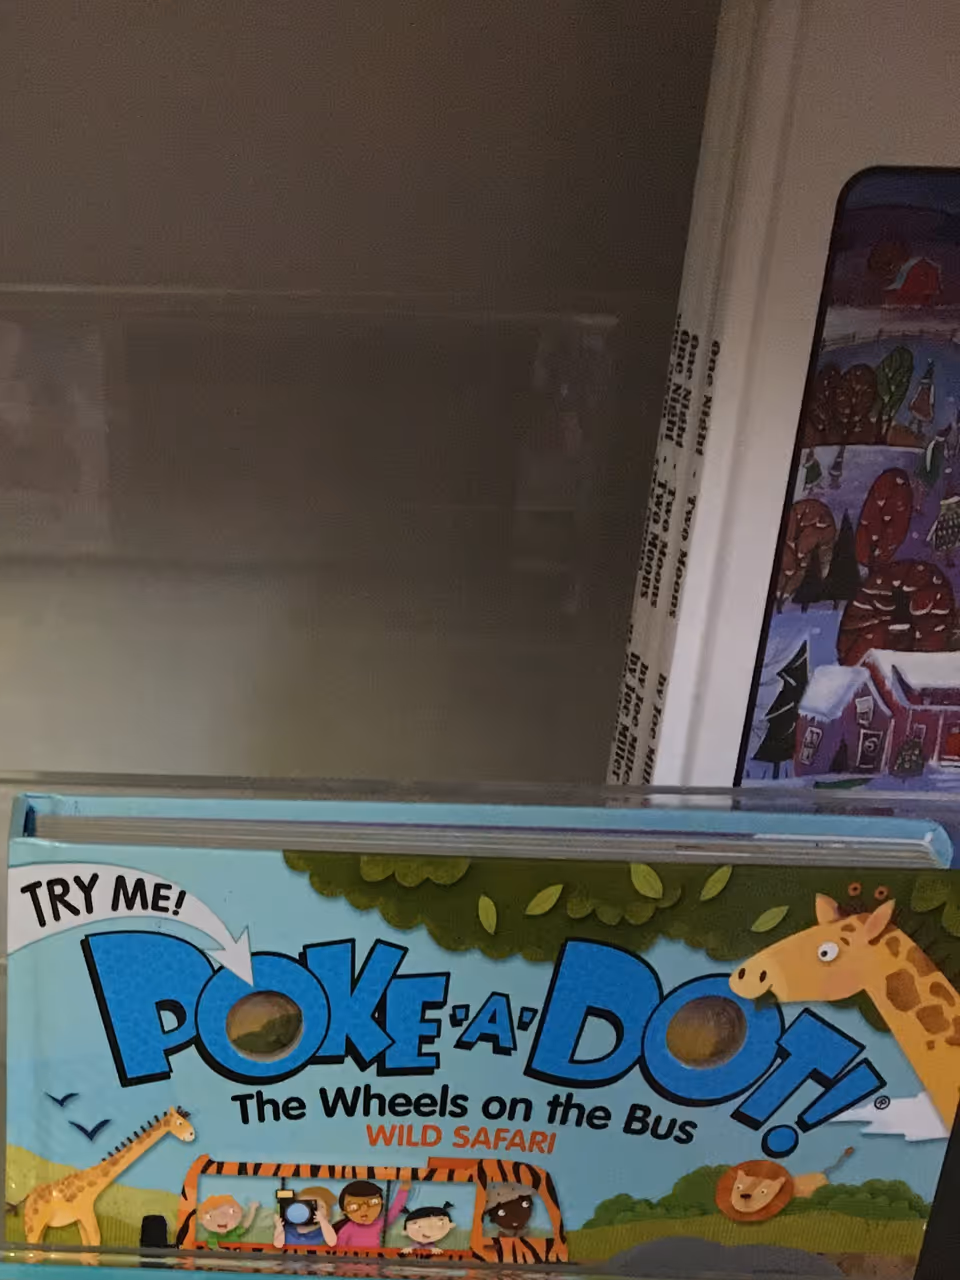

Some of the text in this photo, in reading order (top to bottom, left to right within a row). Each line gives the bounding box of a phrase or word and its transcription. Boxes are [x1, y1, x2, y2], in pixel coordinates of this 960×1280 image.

[674, 329, 690, 374] One
[665, 382, 682, 441] Night
[652, 480, 667, 525] Two
[662, 487, 676, 532] Two
[681, 495, 696, 541] Two
[640, 531, 659, 600] Moons
[651, 540, 668, 608] Moons
[669, 548, 688, 618] Moons
[612, 721, 629, 782] Miller
[622, 732, 638, 785] Mille
[642, 744, 655, 785] Mill
[20, 873, 187, 927] TRY ME!
[231, 1084, 698, 1146] The Wheels on the Bus
[366, 1124, 557, 1155] WILD SAFARI
